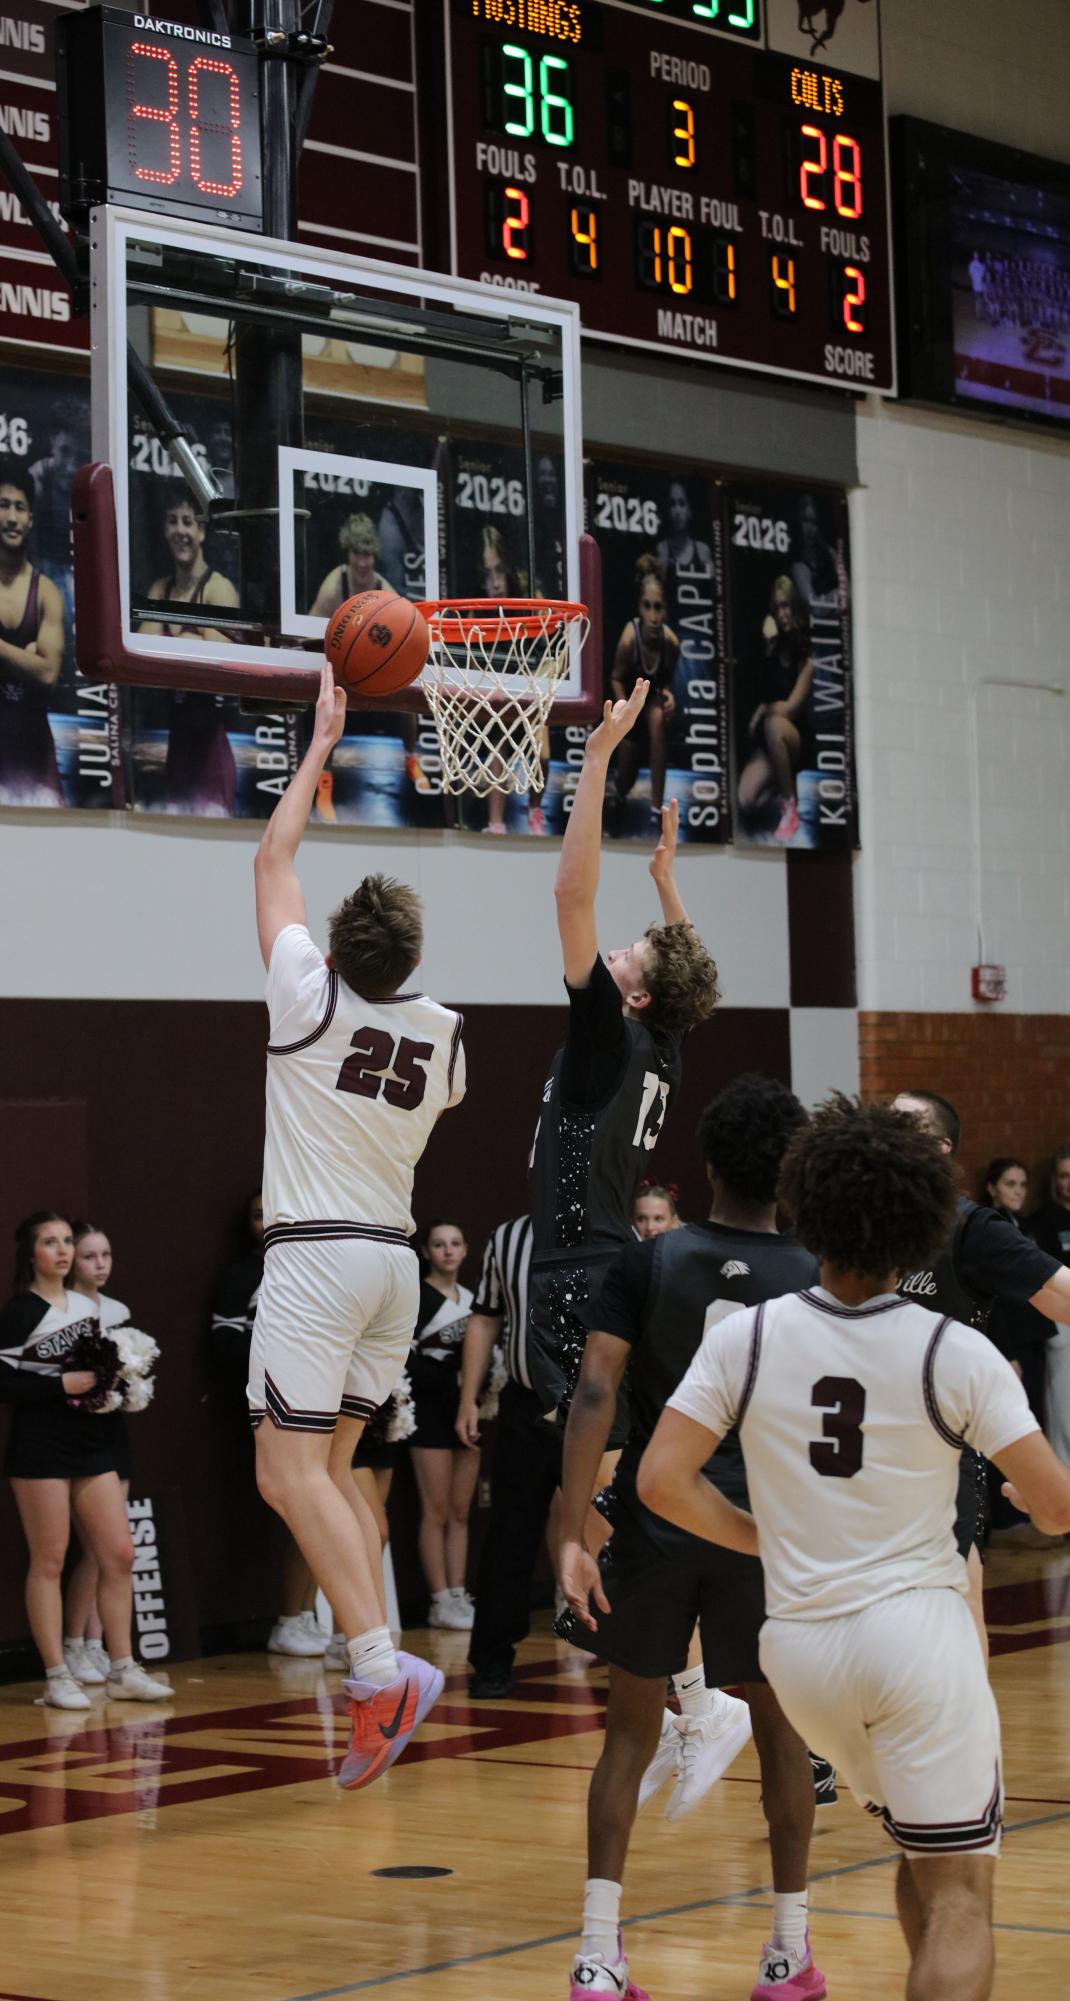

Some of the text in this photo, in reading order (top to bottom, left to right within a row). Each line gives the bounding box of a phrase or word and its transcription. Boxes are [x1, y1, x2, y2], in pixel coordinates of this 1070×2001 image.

[134, 15, 231, 48] DAKTRONICS
[502, 44, 573, 146] 36
[650, 51, 711, 92] PERIOD
[791, 67, 844, 116] COLTS
[130, 43, 242, 197] 30
[673, 100, 696, 168] 3
[476, 142, 537, 183] FOULS
[557, 161, 607, 200] T.O.L.
[800, 125, 862, 219] 28
[503, 187, 529, 259] 2
[628, 179, 743, 232] PLAYER FOUL
[759, 211, 804, 247] T.O.L.
[572, 208, 597, 269] 4
[654, 226, 692, 295] 10
[820, 227, 870, 262] FOULS
[728, 245, 735, 299] 1
[772, 256, 795, 312] 4
[843, 267, 865, 332] 2
[0, 282, 70, 322] NNIS
[657, 309, 718, 347] MATCH
[824, 344, 875, 380] SCORE
[456, 472, 525, 516] 2026
[595, 493, 661, 535] 2026
[732, 514, 791, 552] 2026
[676, 561, 722, 827] Sophia CAPE
[809, 592, 847, 825] KODI WAITE
[75, 665, 113, 787] JULIA
[110, 714, 121, 767] SALINA
[336, 1026, 435, 1111] 25
[632, 1071, 670, 1151] 13
[809, 1376, 866, 1478] 3
[128, 1498, 169, 1659] OFFENSE
